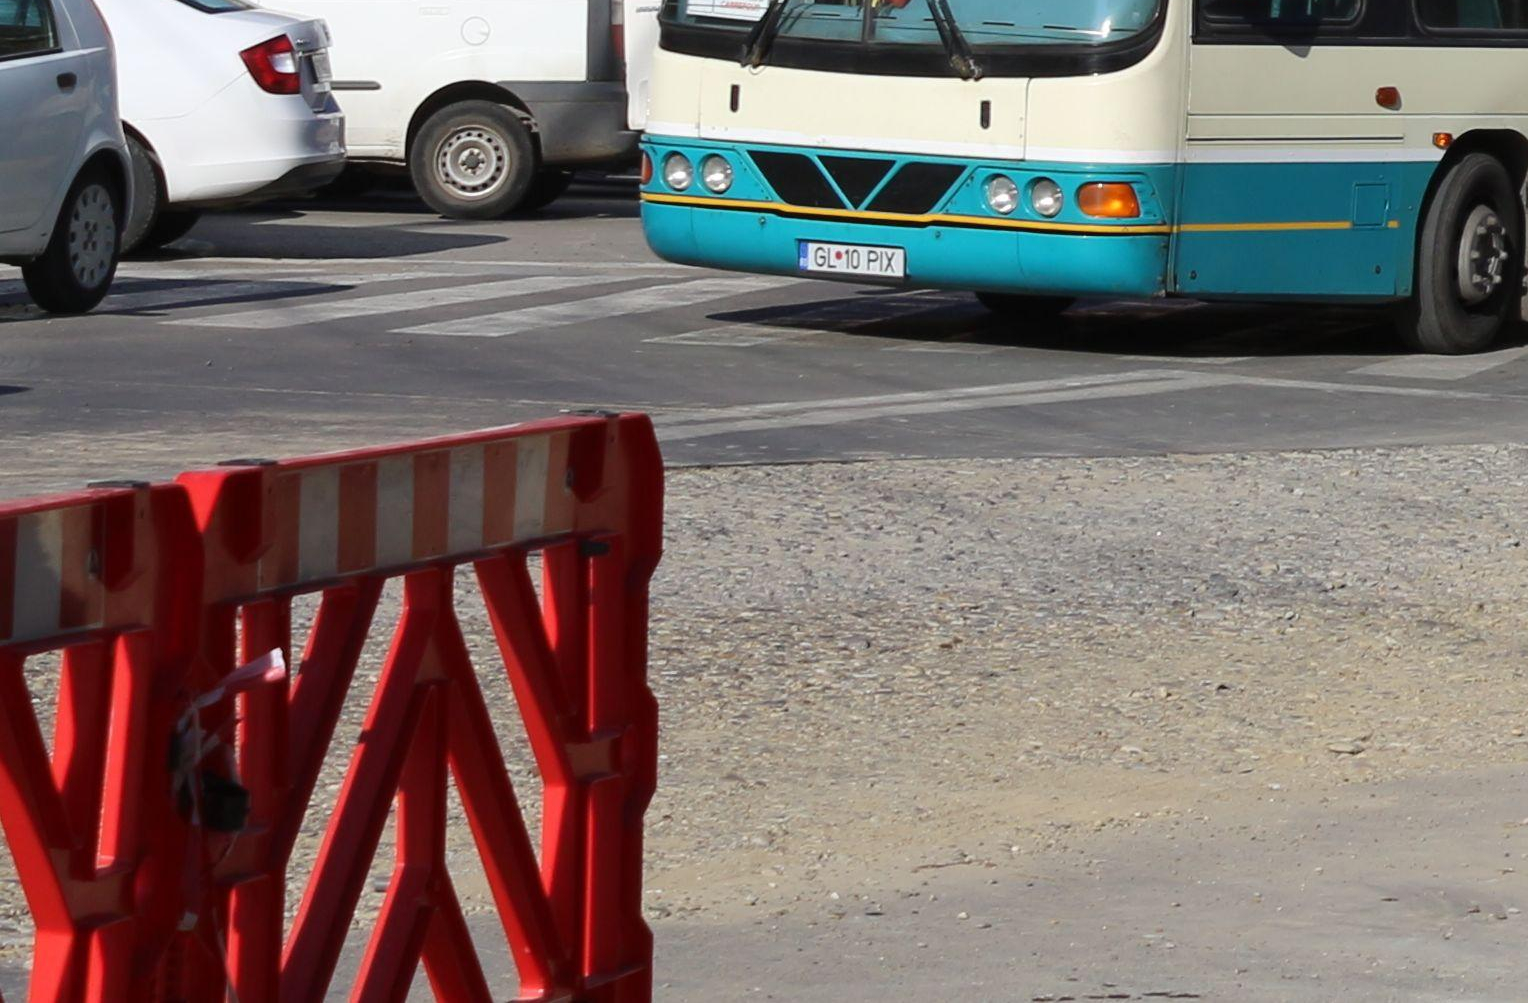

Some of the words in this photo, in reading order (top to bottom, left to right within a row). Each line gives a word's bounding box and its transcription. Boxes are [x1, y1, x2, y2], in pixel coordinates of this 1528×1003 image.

[814, 246, 837, 269] GL
[844, 248, 861, 270] 10
[867, 249, 896, 273] PIX
